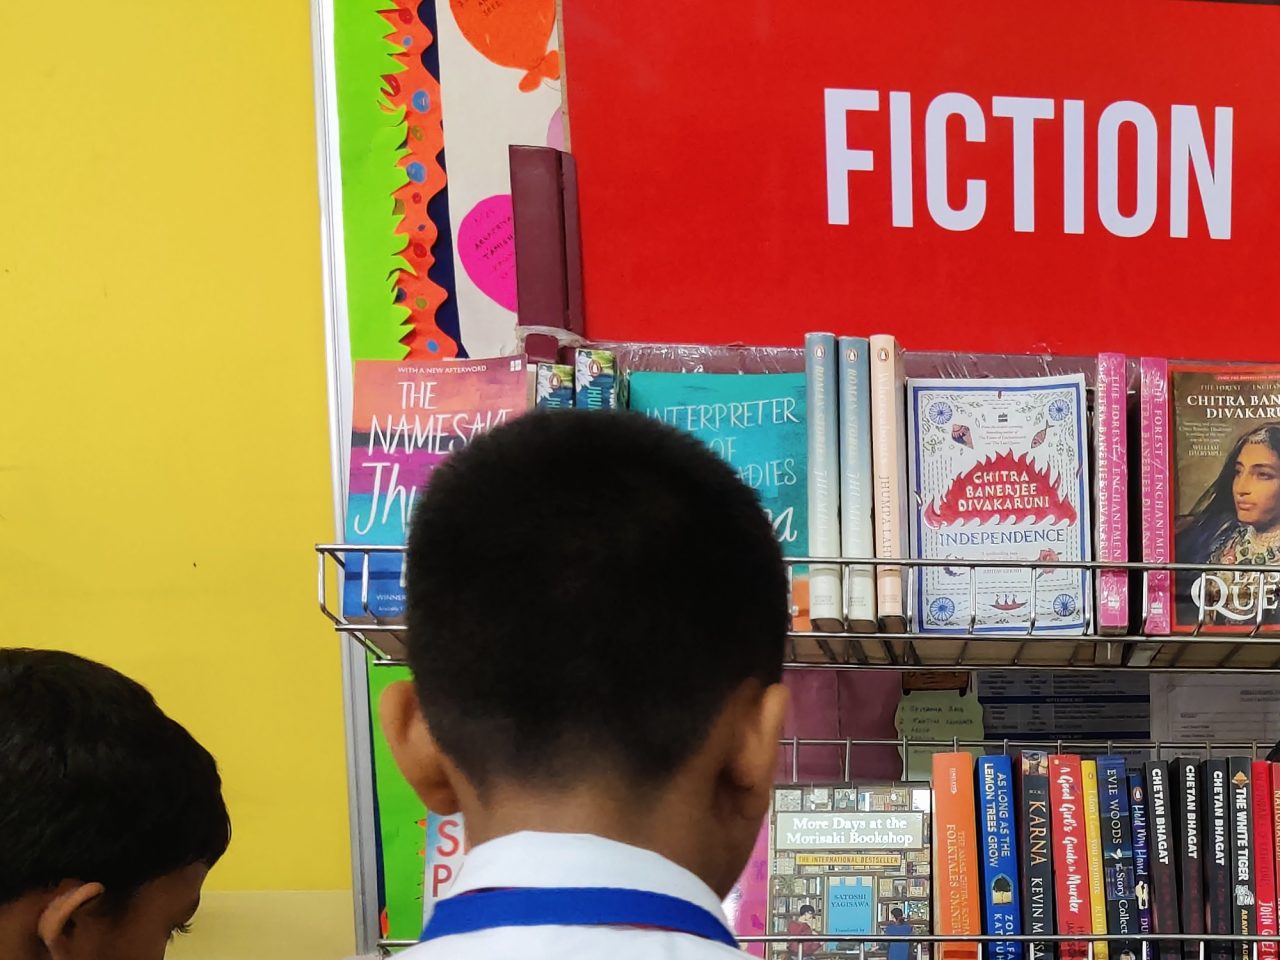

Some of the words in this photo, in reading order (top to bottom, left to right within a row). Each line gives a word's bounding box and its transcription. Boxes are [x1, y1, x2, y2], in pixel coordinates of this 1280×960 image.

[823, 87, 1236, 240] FICTION
[398, 381, 438, 410] THE
[1187, 395, 1246, 406] CHITRA
[646, 397, 800, 432] INTERPRETER
[966, 484, 1038, 498] BANERJEE
[972, 470, 1030, 485] CHITRA
[958, 496, 1051, 512] DIVAKARUNI
[938, 528, 1066, 546] INDEPENDENCE
[984, 763, 995, 800] LEMON
[997, 773, 1006, 786] AS
[1058, 775, 1075, 800] Good
[1107, 769, 1118, 796] EVIE
[1152, 768, 1164, 816] CHETAN
[1185, 765, 1196, 811] CHETAN
[1213, 770, 1223, 817] CHETAN
[998, 789, 1008, 818] LONG
[1235, 788, 1247, 809] THE
[792, 816, 830, 832] More
[832, 816, 869, 834] Days
[872, 818, 887, 832] at
[888, 816, 908, 830] the
[986, 802, 997, 832] TREES
[1000, 820, 1009, 834] AS
[1060, 803, 1077, 832] Girl's
[1109, 798, 1122, 845] WOODS
[1132, 804, 1146, 826] Hold
[786, 831, 846, 846] Morisaki
[849, 830, 915, 848] Bookshop
[1028, 800, 1047, 866] KARNA
[1134, 828, 1147, 848] My
[1156, 818, 1168, 864] BHAGAT
[1186, 812, 1198, 859] BHAGAT
[1214, 818, 1224, 866] BHAGAT
[1236, 812, 1248, 848] WHITE
[799, 856, 811, 864] THE
[812, 856, 858, 864] INTERNATIONAL
[860, 856, 900, 864] BESTSELLER
[946, 824, 958, 887] FOLKTALES
[988, 835, 999, 868] GROW
[1001, 836, 1010, 857] THE
[1063, 836, 1078, 865] Guide
[1134, 849, 1148, 876] Hand
[1238, 850, 1250, 881] TIGER
[830, 900, 870, 909] YAGISAWA
[833, 892, 867, 901] SATOSHI
[1031, 878, 1044, 918] KEVIN
[1066, 874, 1082, 914] Murder
[1260, 900, 1274, 924] JOHN
